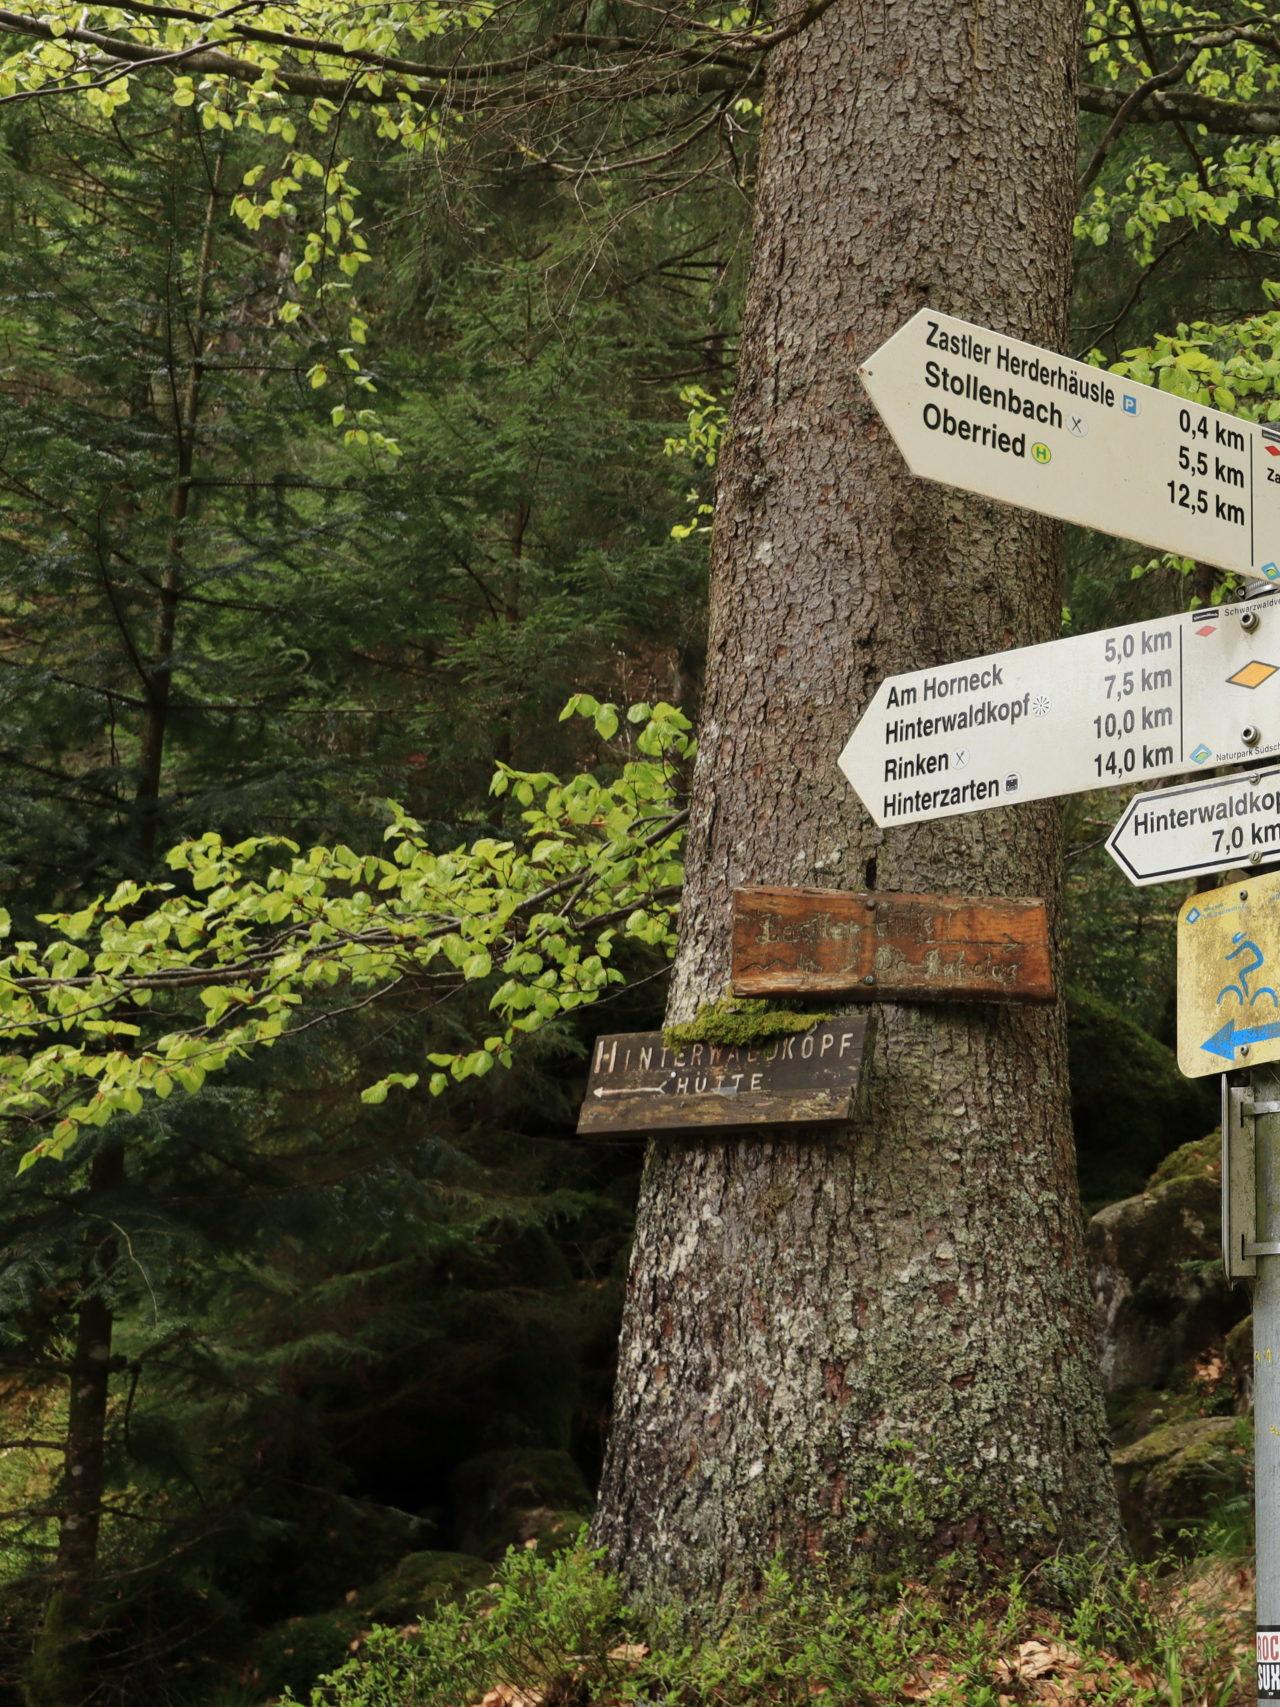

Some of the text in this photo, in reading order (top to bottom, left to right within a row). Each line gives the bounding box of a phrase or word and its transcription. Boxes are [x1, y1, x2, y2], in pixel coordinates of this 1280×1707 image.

[925, 361, 1245, 488] Stollenbach 5,5 km
[926, 321, 991, 365] Zastler
[997, 345, 1115, 407] Herderhäusle
[1179, 408, 1209, 440] 0,4
[1216, 419, 1245, 452] km
[923, 403, 1026, 458] Oberried
[1167, 480, 1208, 514] 12,5
[1216, 492, 1245, 526] km
[885, 667, 1173, 745] Hinterwaldkopf 7,5 km
[886, 629, 1173, 709] Am Horneck 5,0 km
[883, 744, 1174, 818] Hinterzarten 14,0 km
[884, 705, 1173, 783] Rinken 10,0 km
[1216, 748, 1253, 761] Naturpark
[1212, 826, 1244, 855] 7,0
